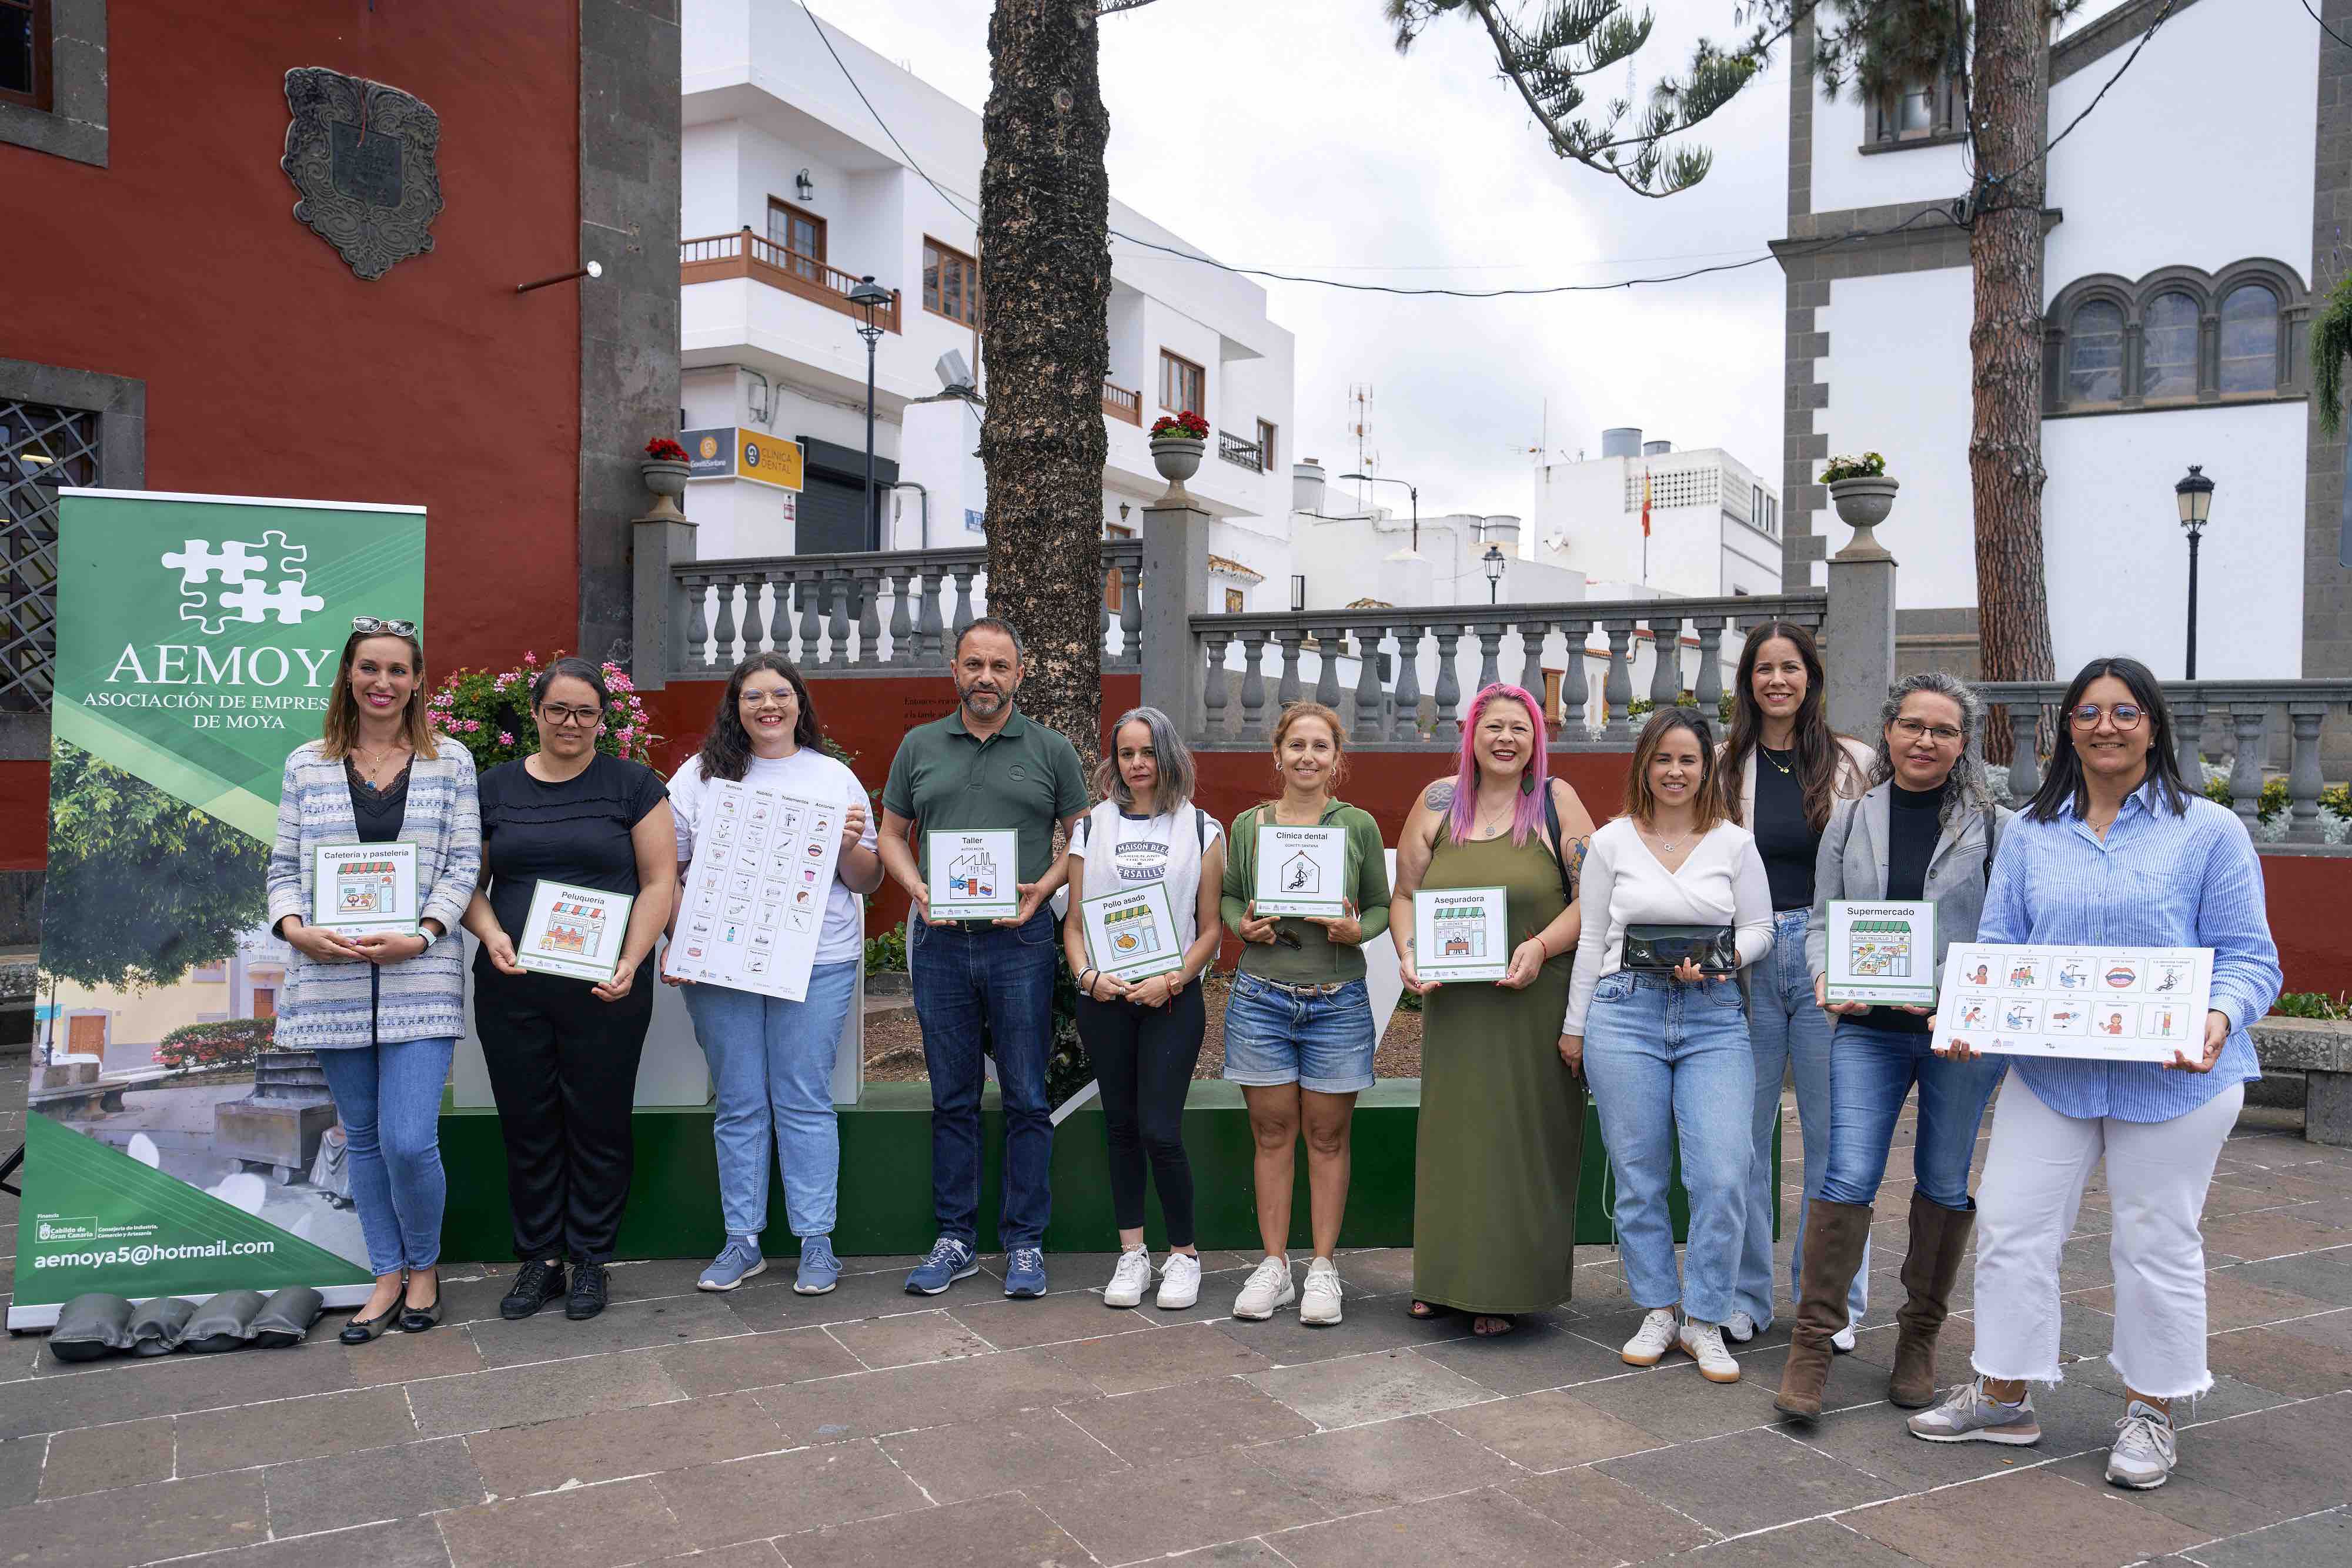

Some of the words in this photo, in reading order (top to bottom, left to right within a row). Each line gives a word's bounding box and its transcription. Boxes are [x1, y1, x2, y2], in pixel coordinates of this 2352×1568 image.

[761, 460, 790, 474] DENTAL
[105, 643, 338, 687] AEMOY
[83, 691, 212, 708] ASOCIACIÓN
[219, 696, 245, 709] DE
[252, 696, 330, 710] EMPRES
[194, 716, 221, 728] DE
[227, 716, 286, 730] MOYA
[781, 795, 809, 804] Tratamientos
[325, 851, 360, 859] Cafetería
[370, 850, 409, 858] pastelería
[1118, 844, 1148, 852] MAISON
[1151, 844, 1167, 852] BLE
[1118, 866, 1165, 878] ERSAILLE
[562, 891, 605, 905] Peluquería
[1103, 900, 1122, 910] Pollo
[1124, 894, 1145, 905] asado
[1434, 896, 1484, 904] Aseguradora
[1847, 907, 1915, 918] Supermercado
[34, 1239, 275, 1269] aemoya5@hotmail.com
